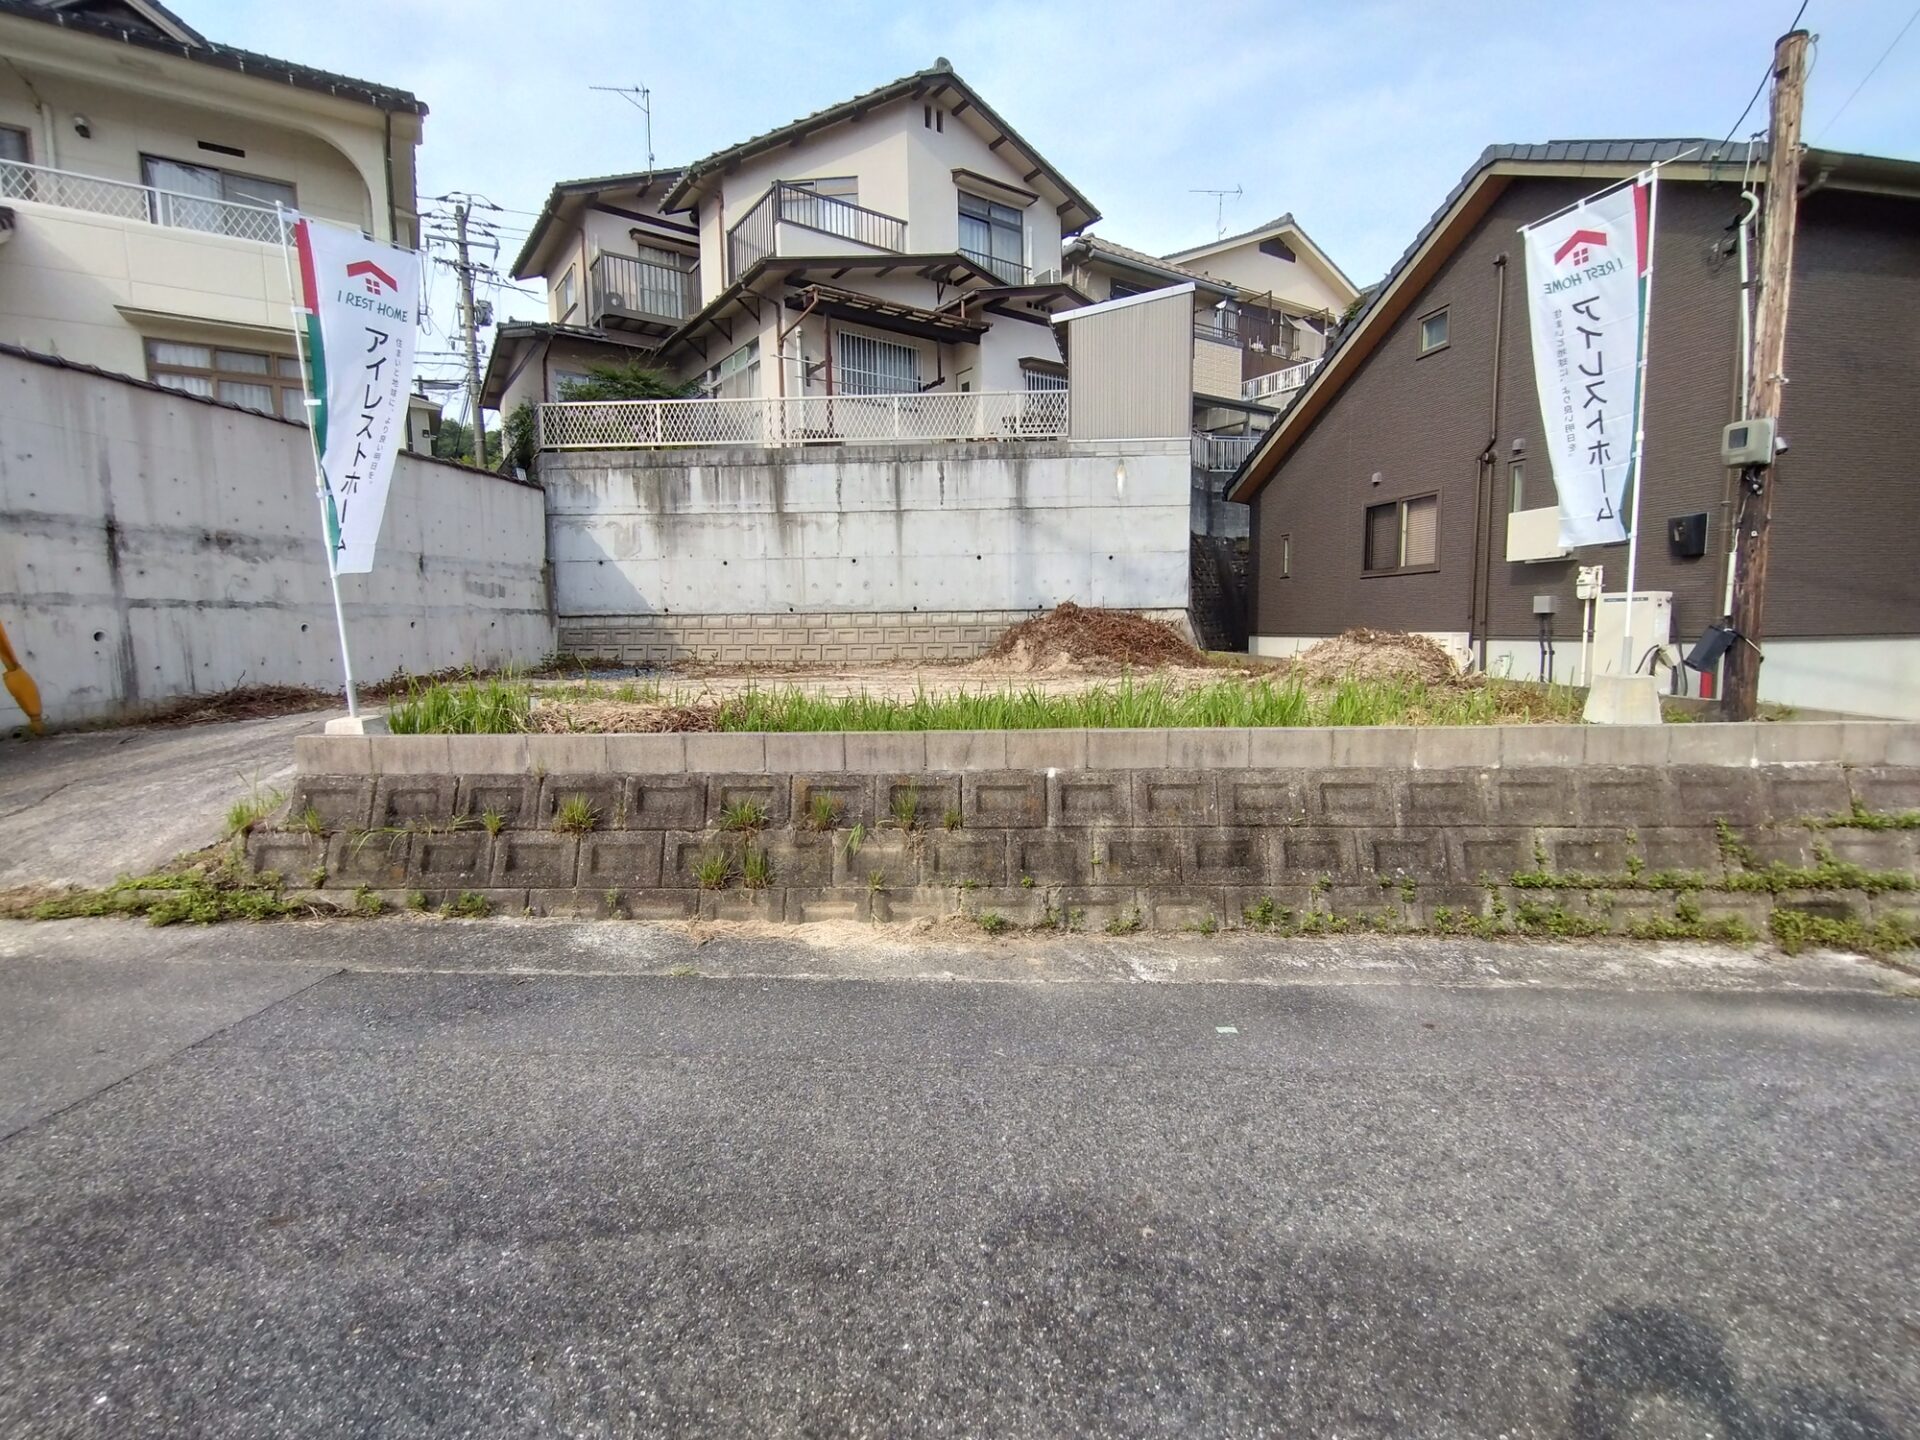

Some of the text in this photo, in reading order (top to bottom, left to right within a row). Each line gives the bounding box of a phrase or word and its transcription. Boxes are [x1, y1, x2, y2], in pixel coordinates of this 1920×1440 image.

[337, 290, 408, 323] I REST HOME
[337, 326, 389, 550] アイレストホーム
